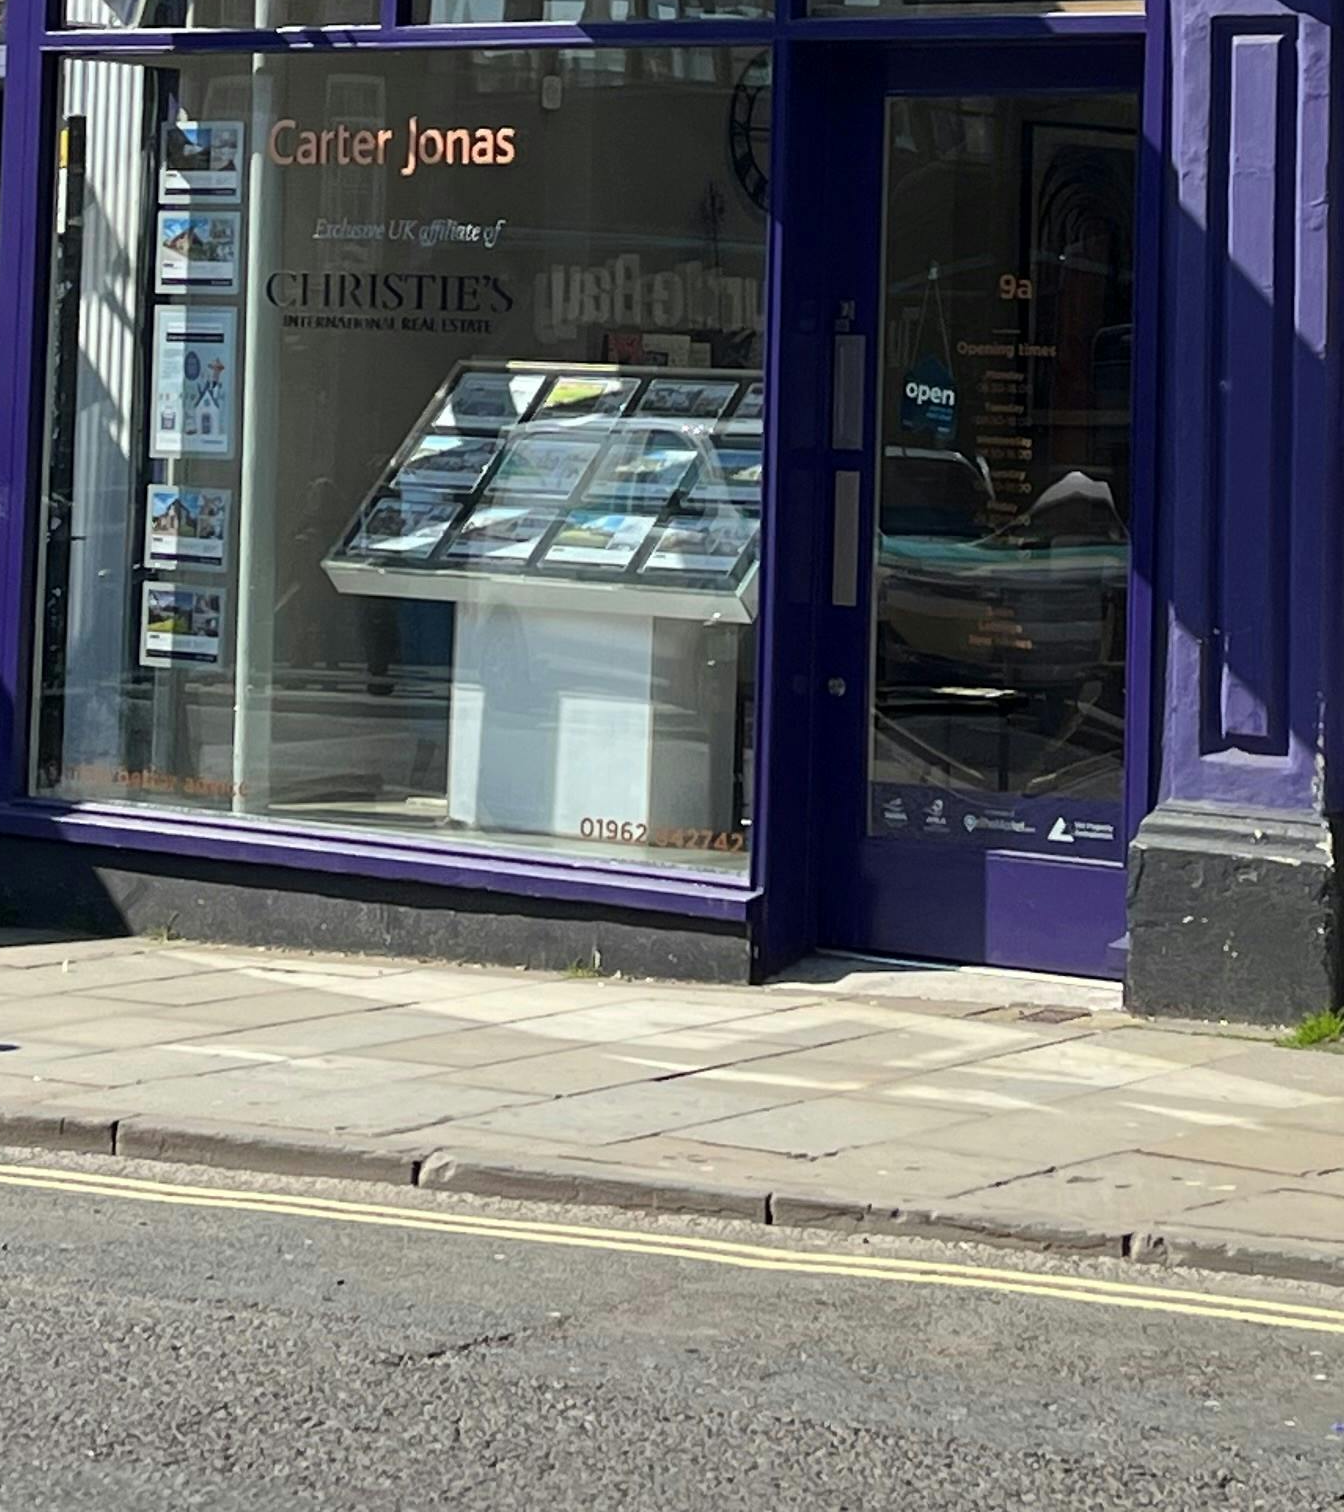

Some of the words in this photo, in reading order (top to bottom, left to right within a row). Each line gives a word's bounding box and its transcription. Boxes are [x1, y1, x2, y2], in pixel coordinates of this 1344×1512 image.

[269, 118, 393, 166] Carter
[400, 115, 516, 176] Jonas
[388, 219, 420, 240] UK
[419, 218, 481, 248] affiliate
[482, 219, 507, 249] of
[998, 273, 1033, 300] 9a
[282, 314, 395, 332] INTERNATIONAL
[400, 316, 438, 333] REAL
[441, 318, 493, 335] ESTATE
[956, 340, 1015, 359] Opening
[1018, 342, 1057, 358] times
[905, 381, 956, 406] open
[580, 816, 648, 844] 01962
